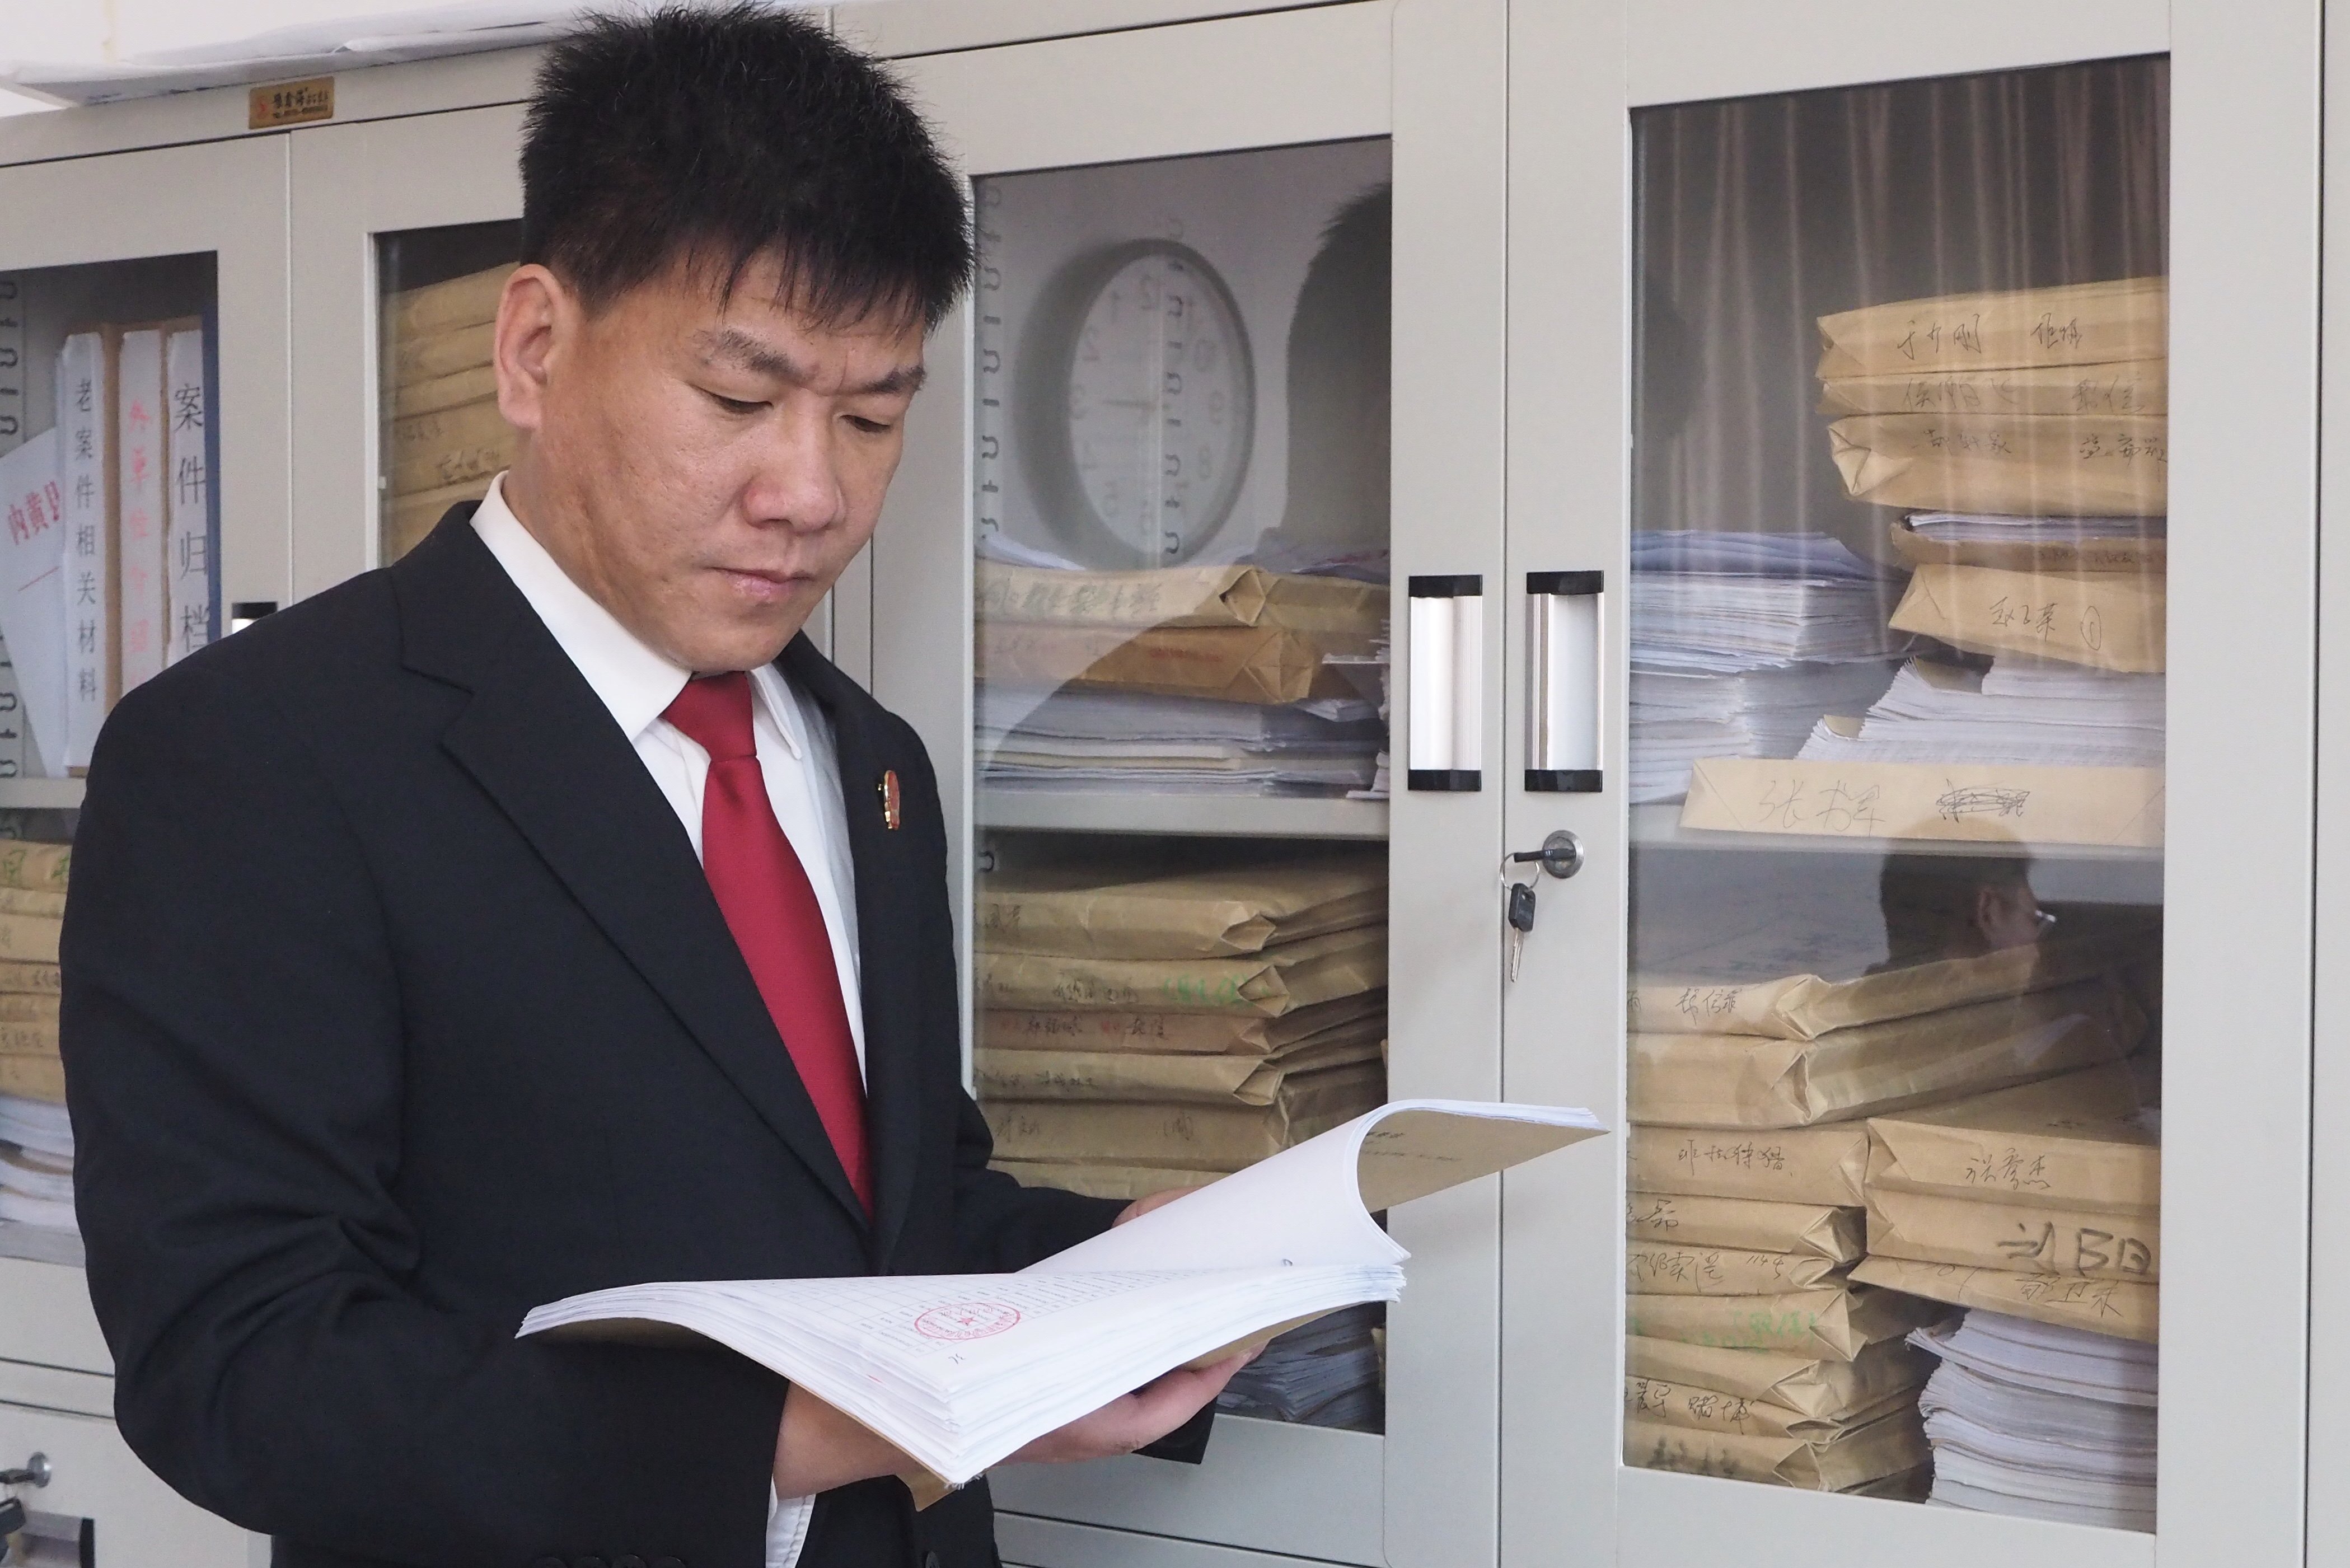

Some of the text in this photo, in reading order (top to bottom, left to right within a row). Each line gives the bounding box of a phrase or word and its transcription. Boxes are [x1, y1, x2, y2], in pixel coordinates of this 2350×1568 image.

[74, 378, 96, 703] 老案件相关材料
[175, 383, 210, 653] 案件归档
